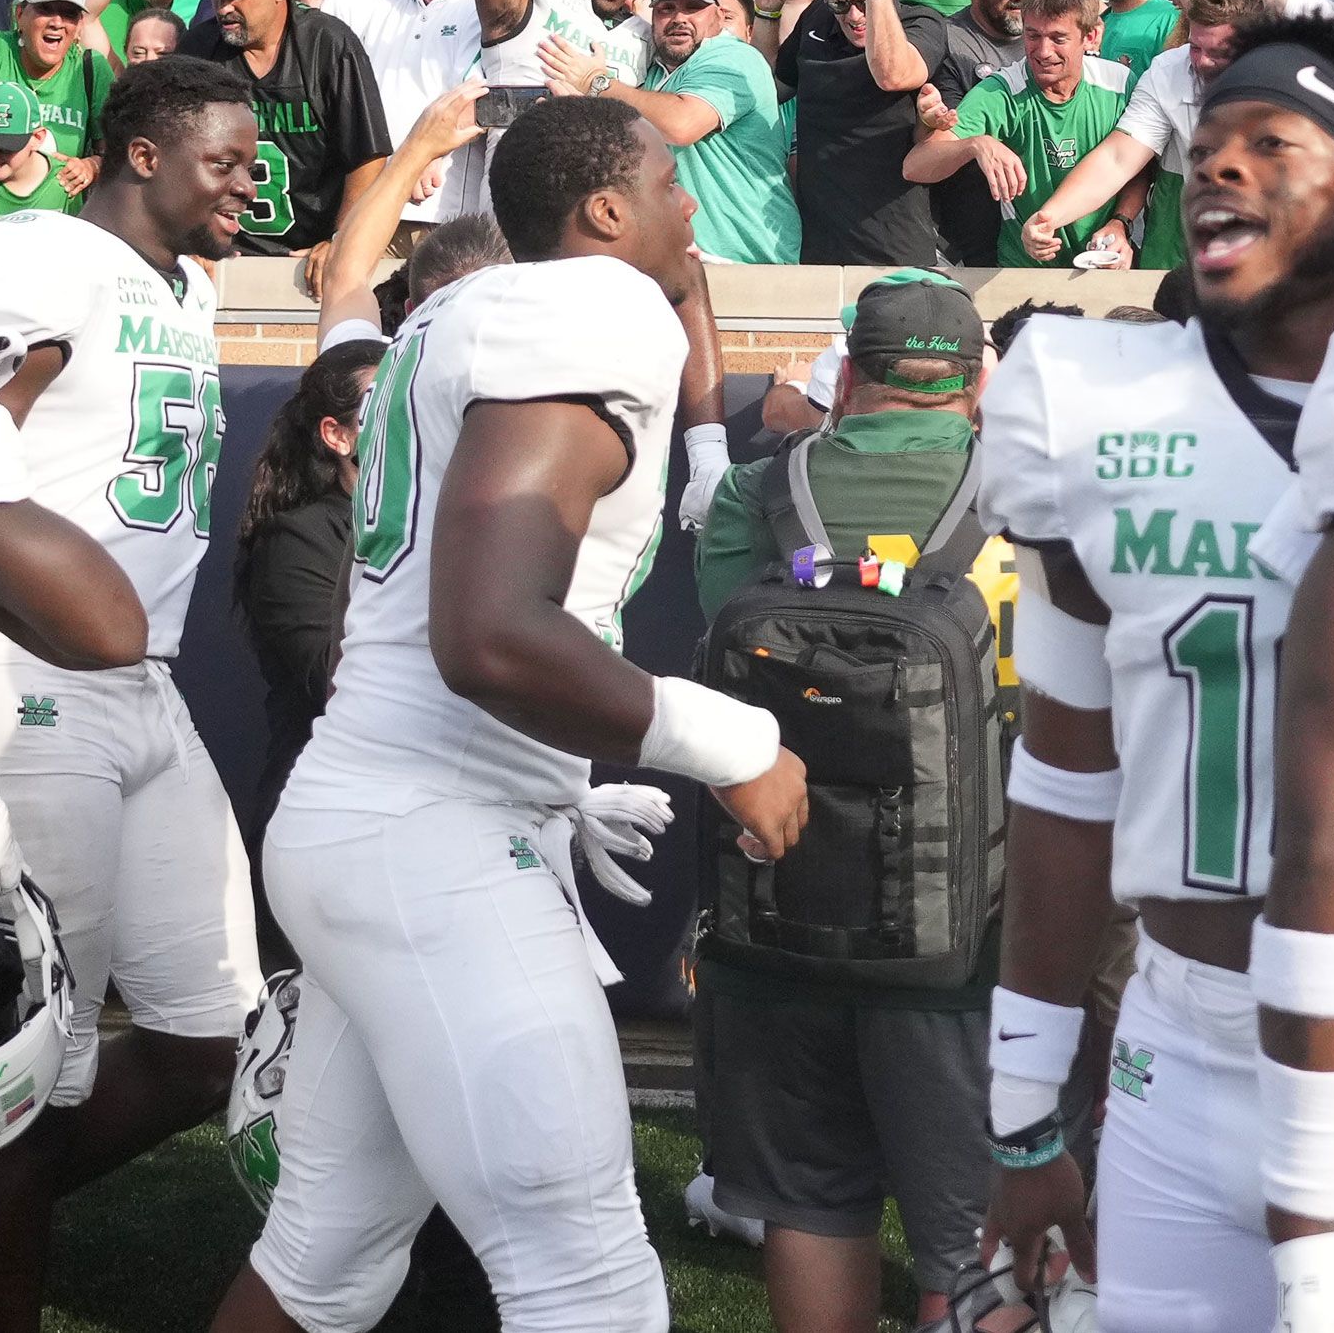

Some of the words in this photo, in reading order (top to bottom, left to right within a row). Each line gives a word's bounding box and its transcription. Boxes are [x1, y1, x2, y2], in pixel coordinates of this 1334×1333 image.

[905, 336, 926, 351] the
[926, 335, 962, 352] Herd
[1096, 430, 1199, 481] SBC
